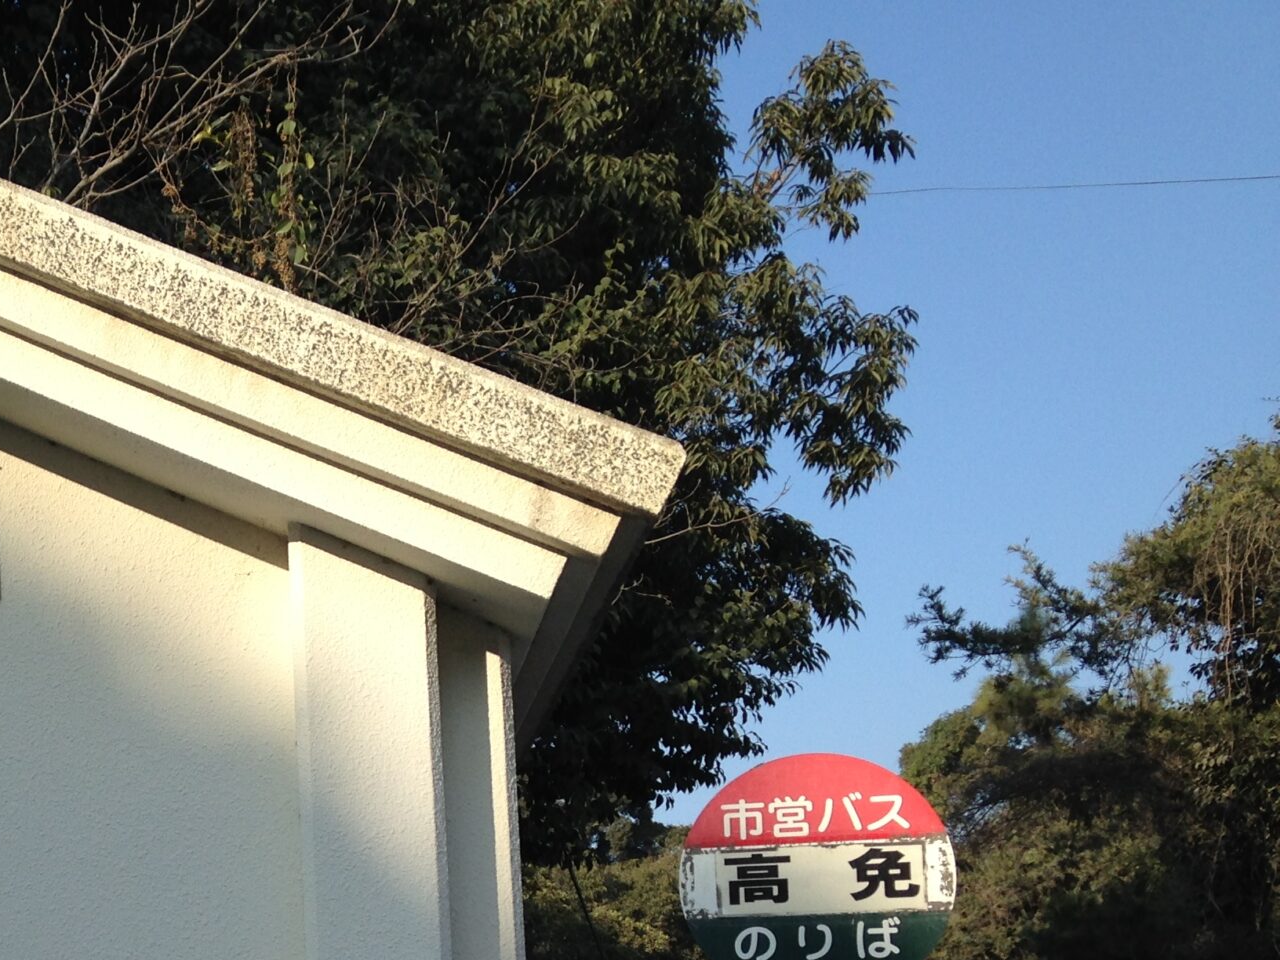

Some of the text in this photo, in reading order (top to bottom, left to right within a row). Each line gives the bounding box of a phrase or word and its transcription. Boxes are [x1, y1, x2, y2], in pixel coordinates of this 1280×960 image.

[720, 791, 910, 840] 市営バス
[723, 847, 921, 906] 高免
